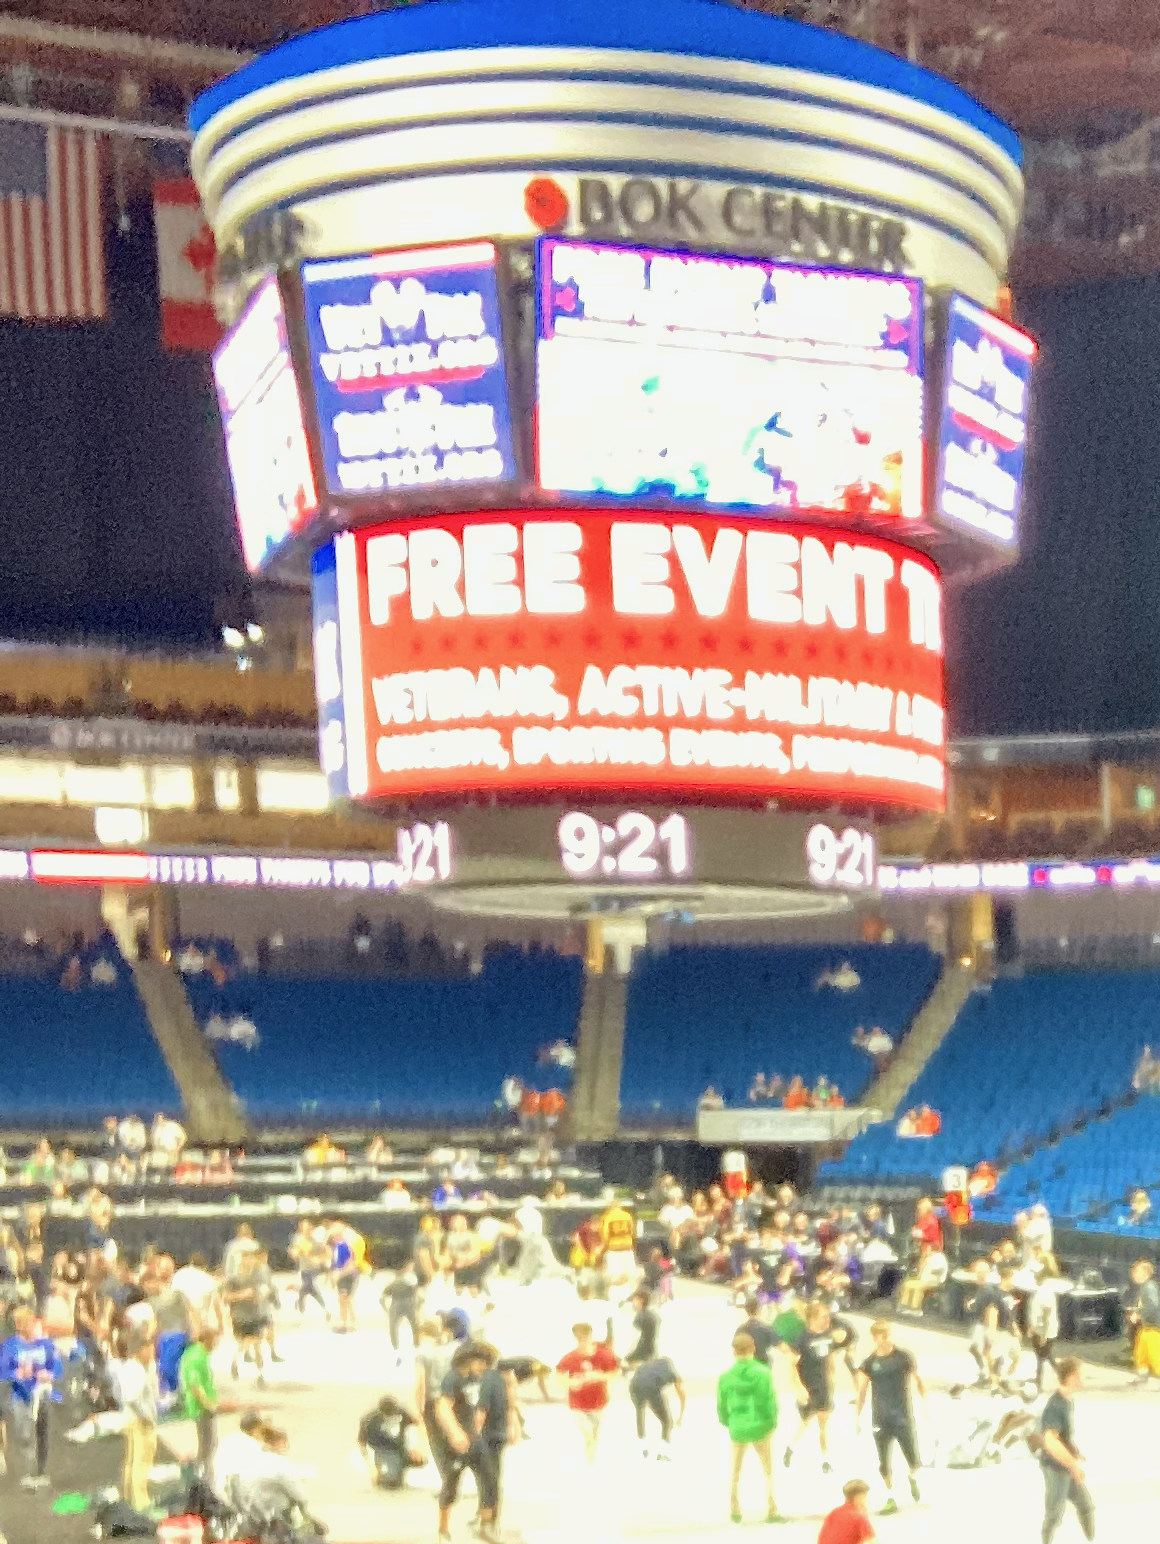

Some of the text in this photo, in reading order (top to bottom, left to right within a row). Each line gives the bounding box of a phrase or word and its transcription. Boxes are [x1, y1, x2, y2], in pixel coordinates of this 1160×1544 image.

[366, 521, 585, 626] FREE
[609, 522, 894, 633] EVENT
[560, 811, 688, 876] 9:21
